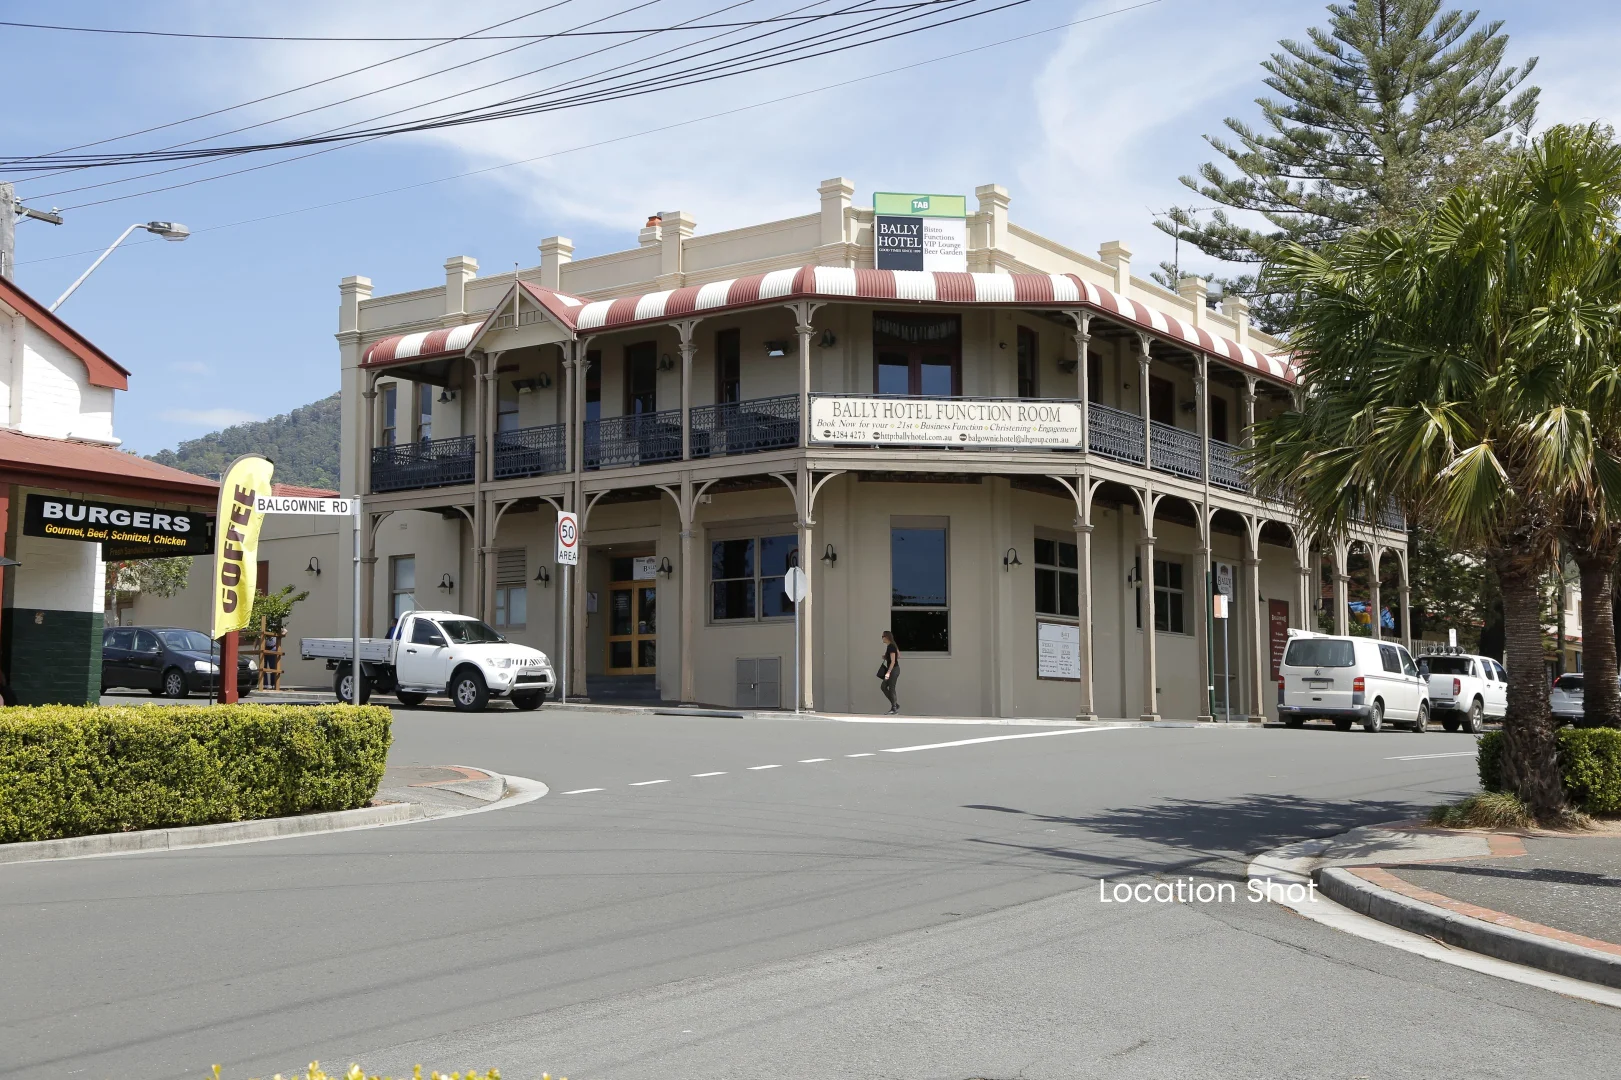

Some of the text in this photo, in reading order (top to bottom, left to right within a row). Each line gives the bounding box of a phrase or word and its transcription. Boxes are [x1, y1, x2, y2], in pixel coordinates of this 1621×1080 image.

[913, 201, 929, 209] TAB
[880, 223, 919, 235] BALLY
[878, 236, 922, 248] HOTEL
[924, 233, 954, 241] Functions
[938, 241, 961, 249] Lounge
[832, 401, 1061, 422] BALLY HOTEL FUNCTION ROOM
[817, 419, 1077, 433] Book Now for your 21st Business Function Christening Engagement
[832, 431, 848, 439] 4284
[257, 498, 348, 513] BALGOWNIE RD
[43, 501, 191, 532] BURGERS
[45, 523, 186, 546] Gourmet, Beef, Schnitzel, Chicken
[562, 524, 574, 539] 50
[221, 484, 256, 614] COFFEE
[559, 550, 577, 561] AREA
